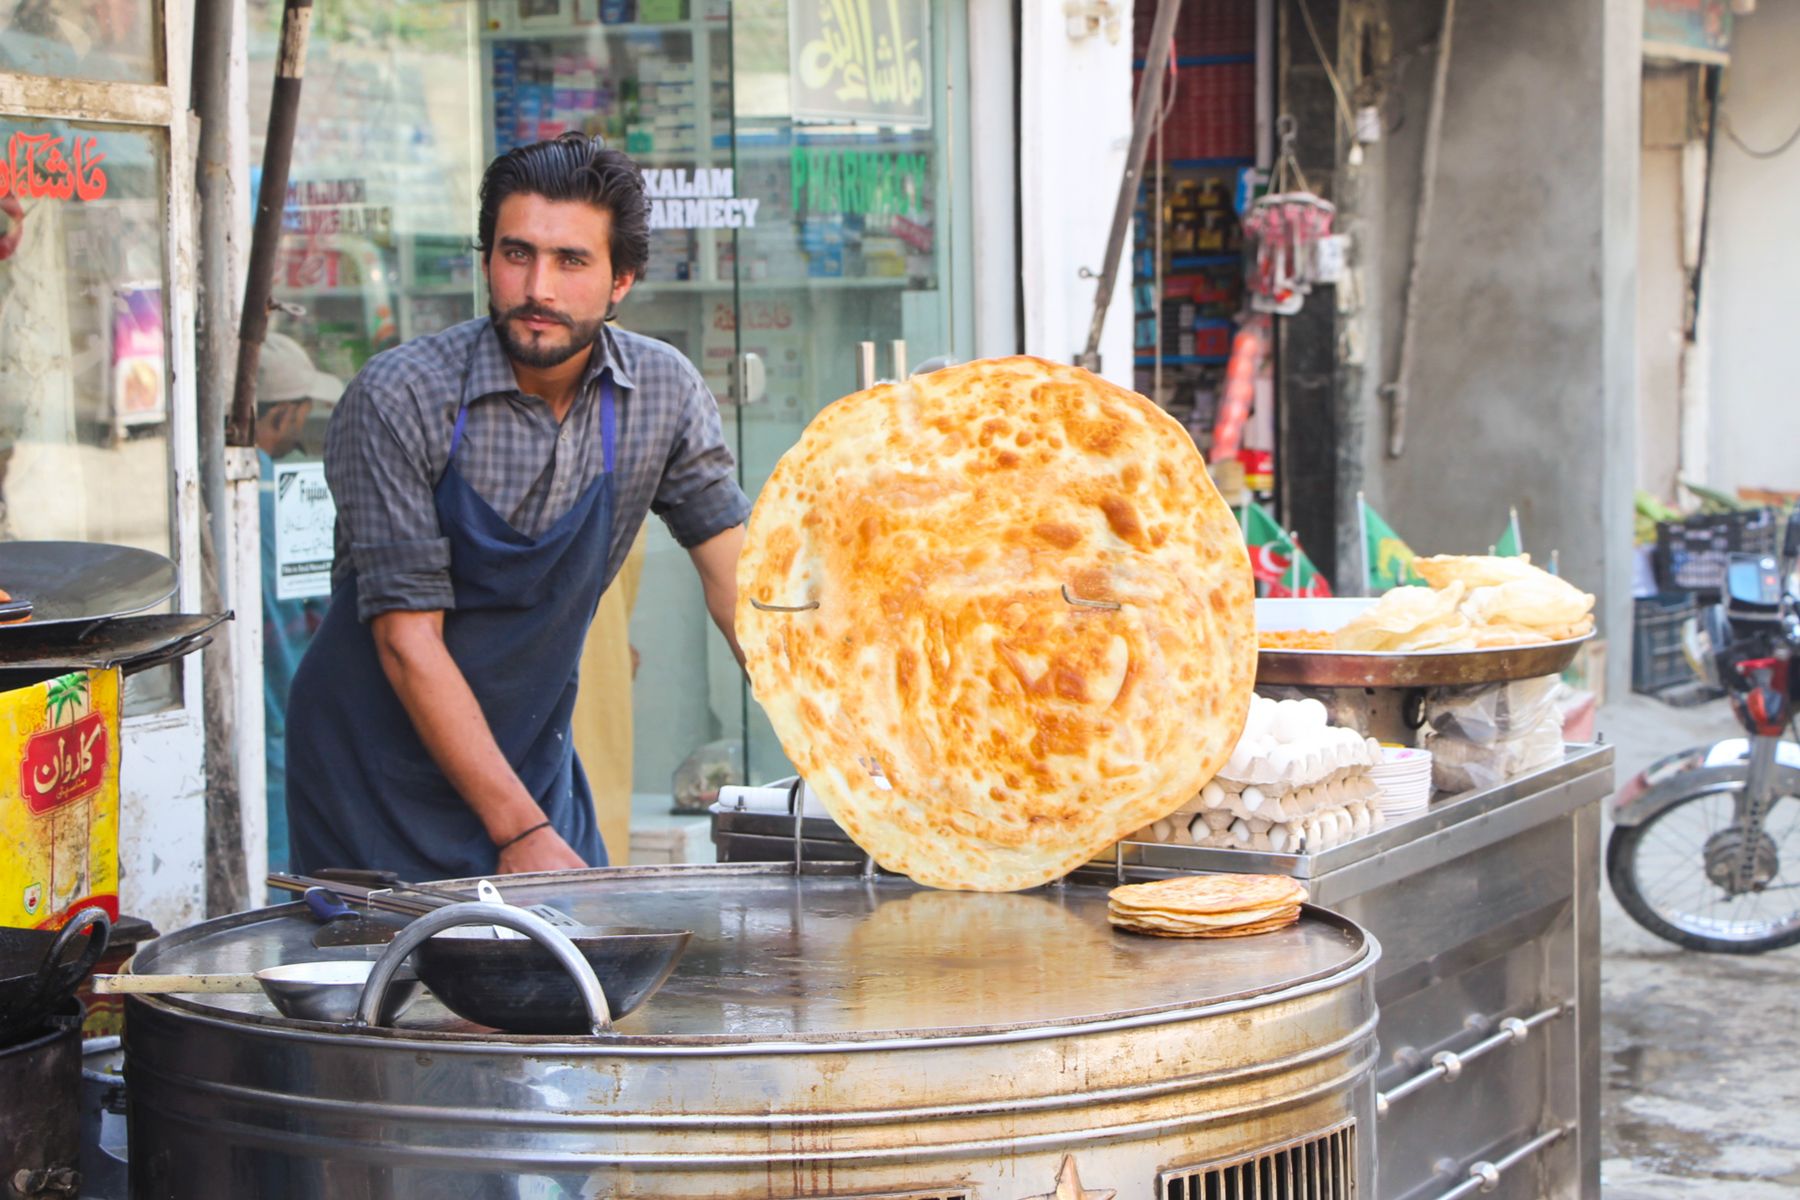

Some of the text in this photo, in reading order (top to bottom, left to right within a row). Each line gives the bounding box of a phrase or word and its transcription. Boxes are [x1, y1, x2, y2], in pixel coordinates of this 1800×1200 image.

[641, 168, 734, 197] KALAM
[791, 148, 926, 215] PHARMACY
[648, 198, 760, 229] ARMECY
